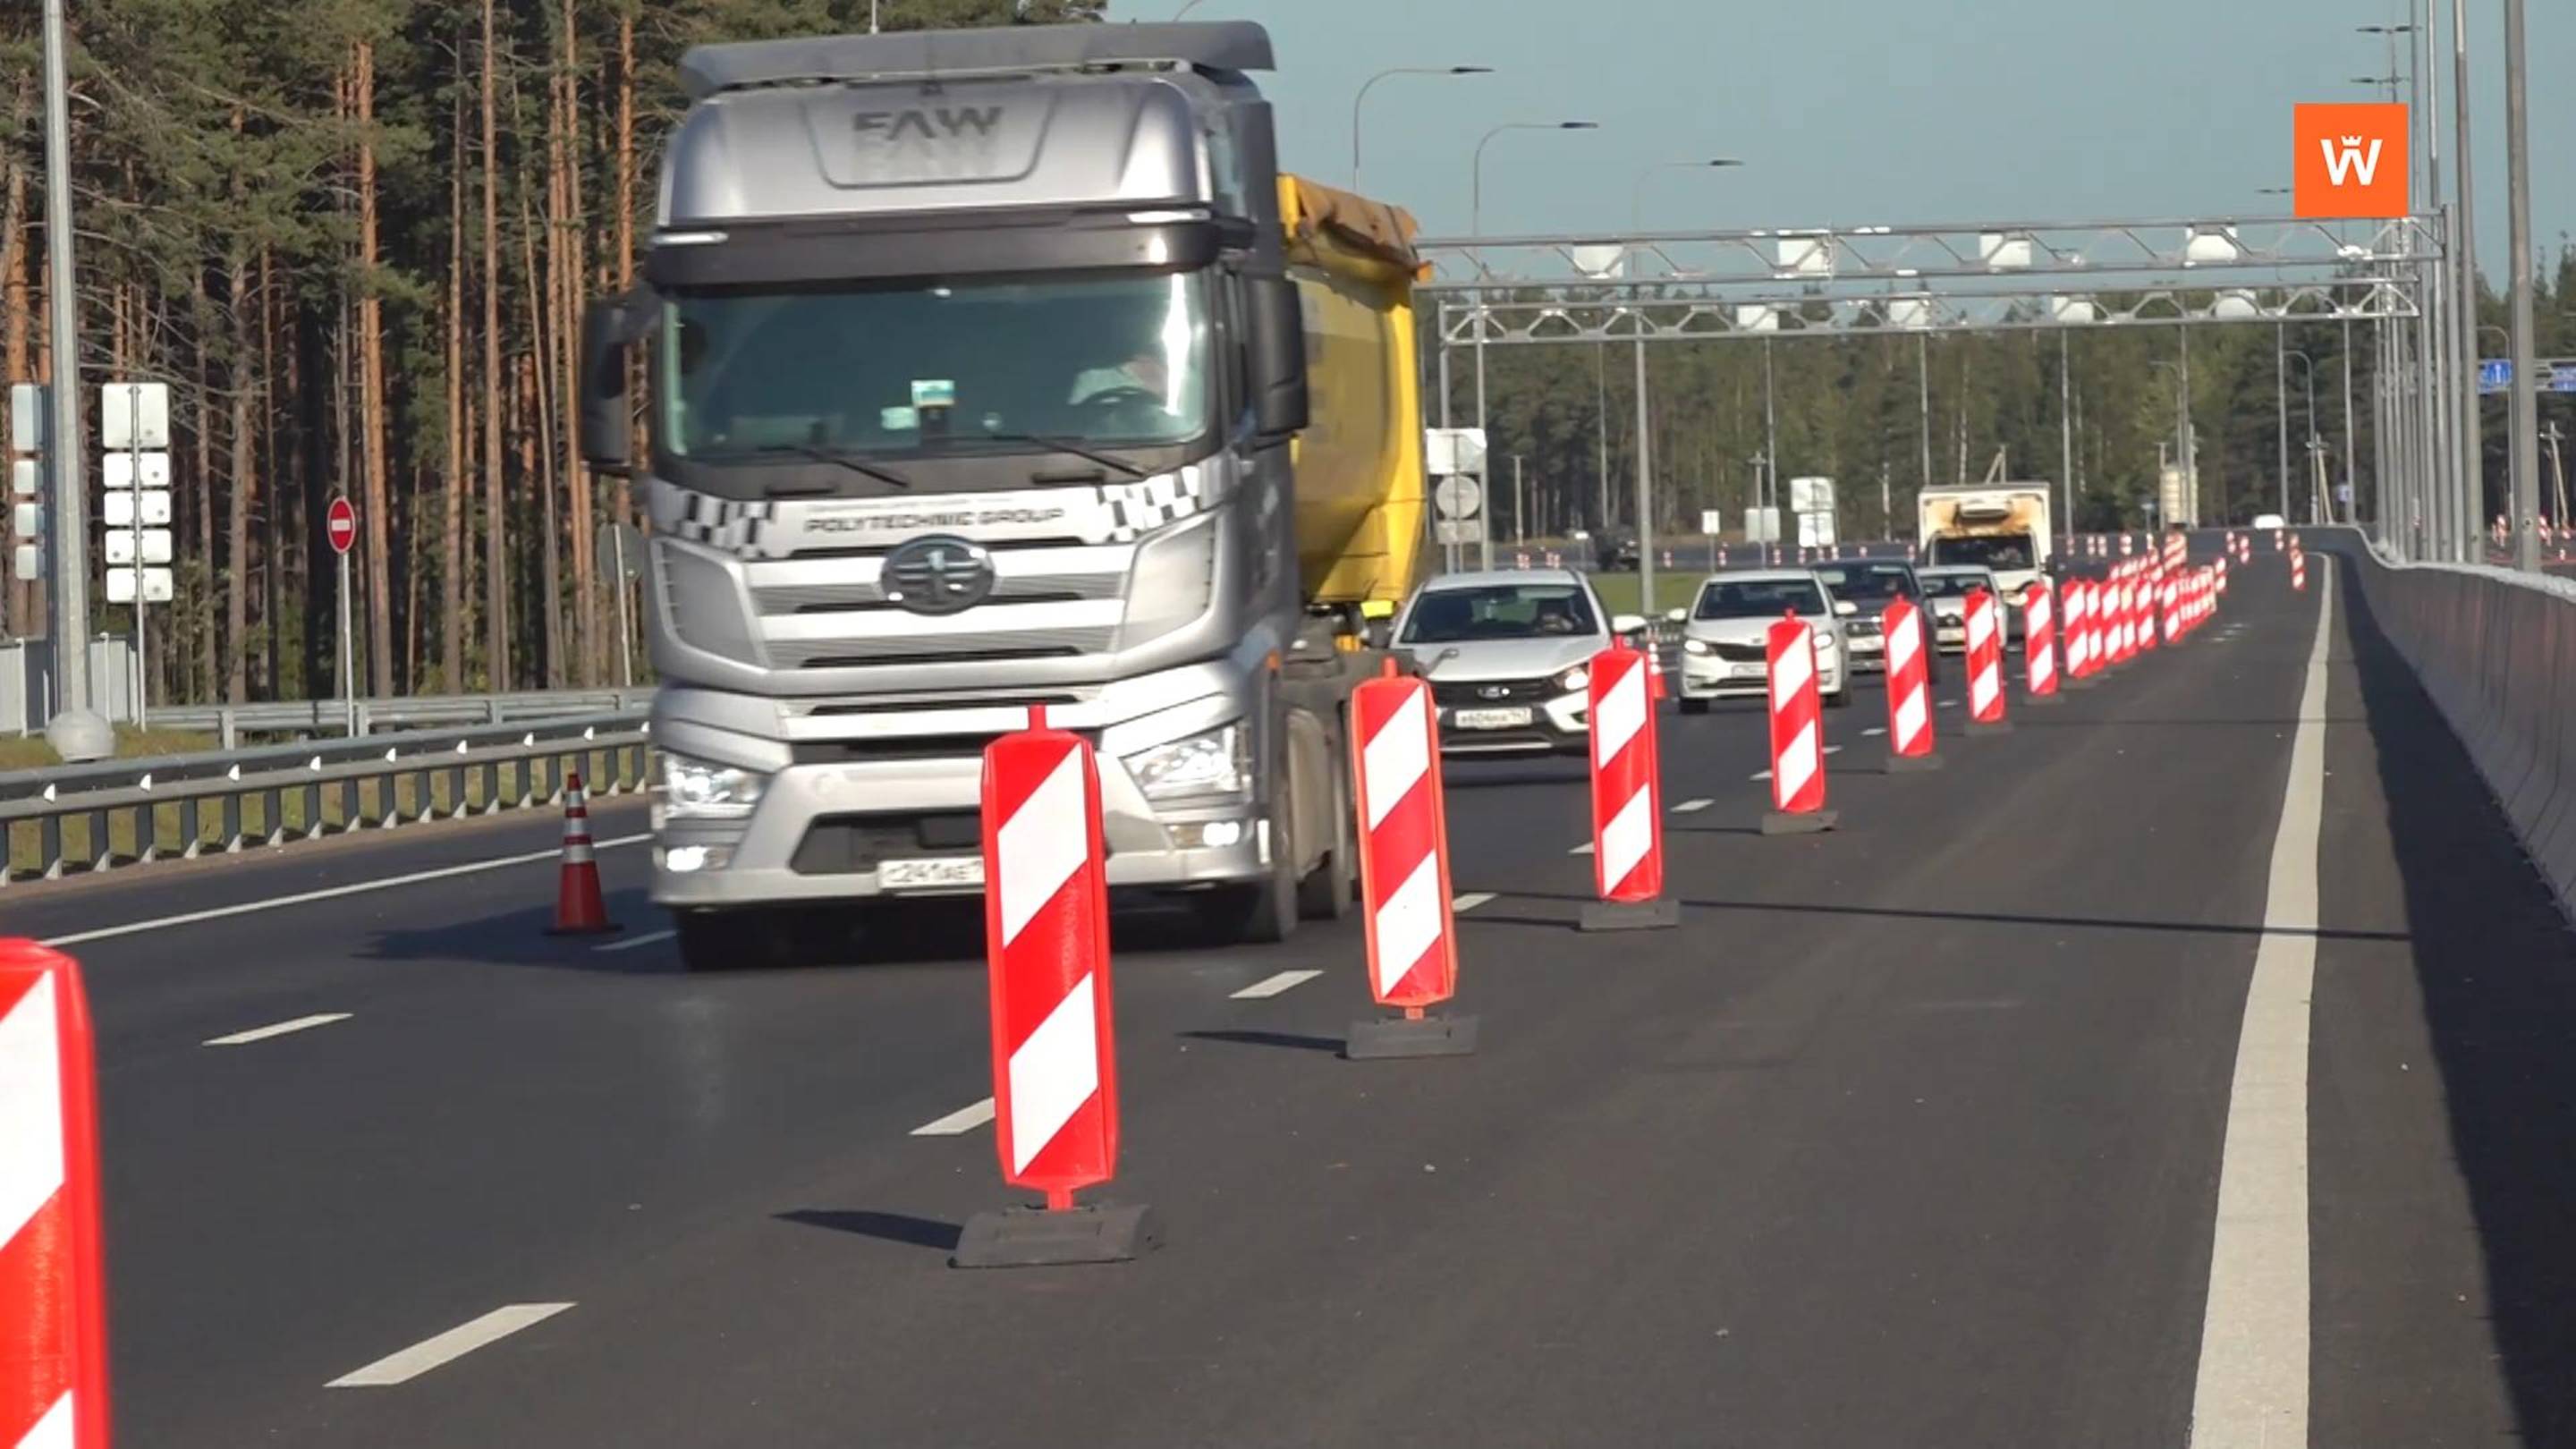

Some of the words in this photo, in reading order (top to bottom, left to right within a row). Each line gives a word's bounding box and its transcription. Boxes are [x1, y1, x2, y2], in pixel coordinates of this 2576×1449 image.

[853, 106, 1004, 140] FAW
[804, 511, 975, 532] POLYTECHNIC
[979, 508, 1064, 524] GROUP
